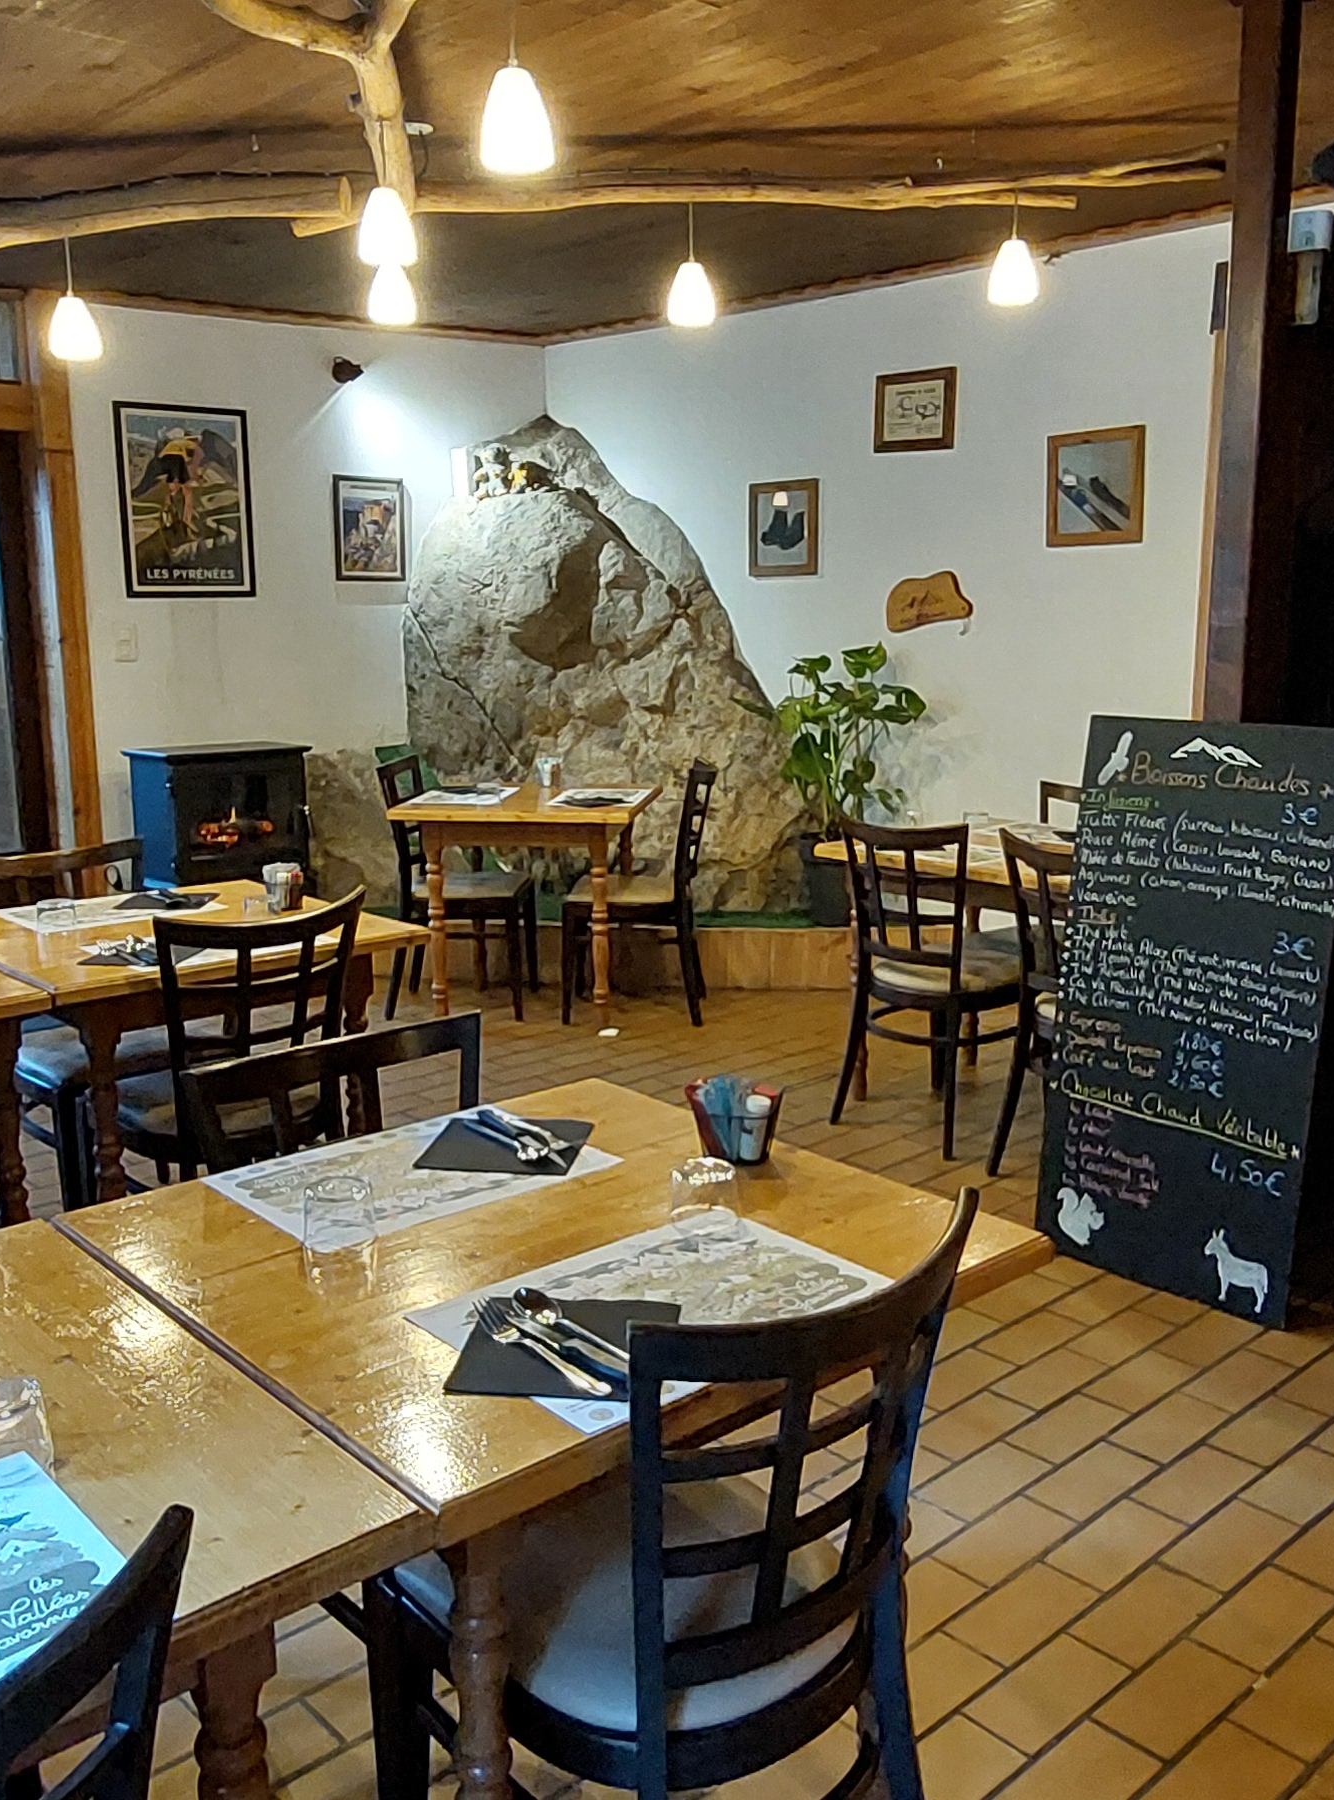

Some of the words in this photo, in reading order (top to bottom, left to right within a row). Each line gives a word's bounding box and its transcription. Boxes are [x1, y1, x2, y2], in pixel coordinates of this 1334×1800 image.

[147, 568, 169, 579] LES
[1131, 751, 1208, 789] Boissons
[1215, 762, 1311, 796] Chaudes
[1282, 803, 1318, 826] 3€
[1078, 865, 1132, 889] Agrumes
[1273, 931, 1315, 960] 3€
[1061, 1069, 1134, 1108] Chocolat
[1141, 1092, 1203, 1128] Chaud
[1212, 1152, 1286, 1198] 4,50€
[29, 1576, 64, 1595] les
